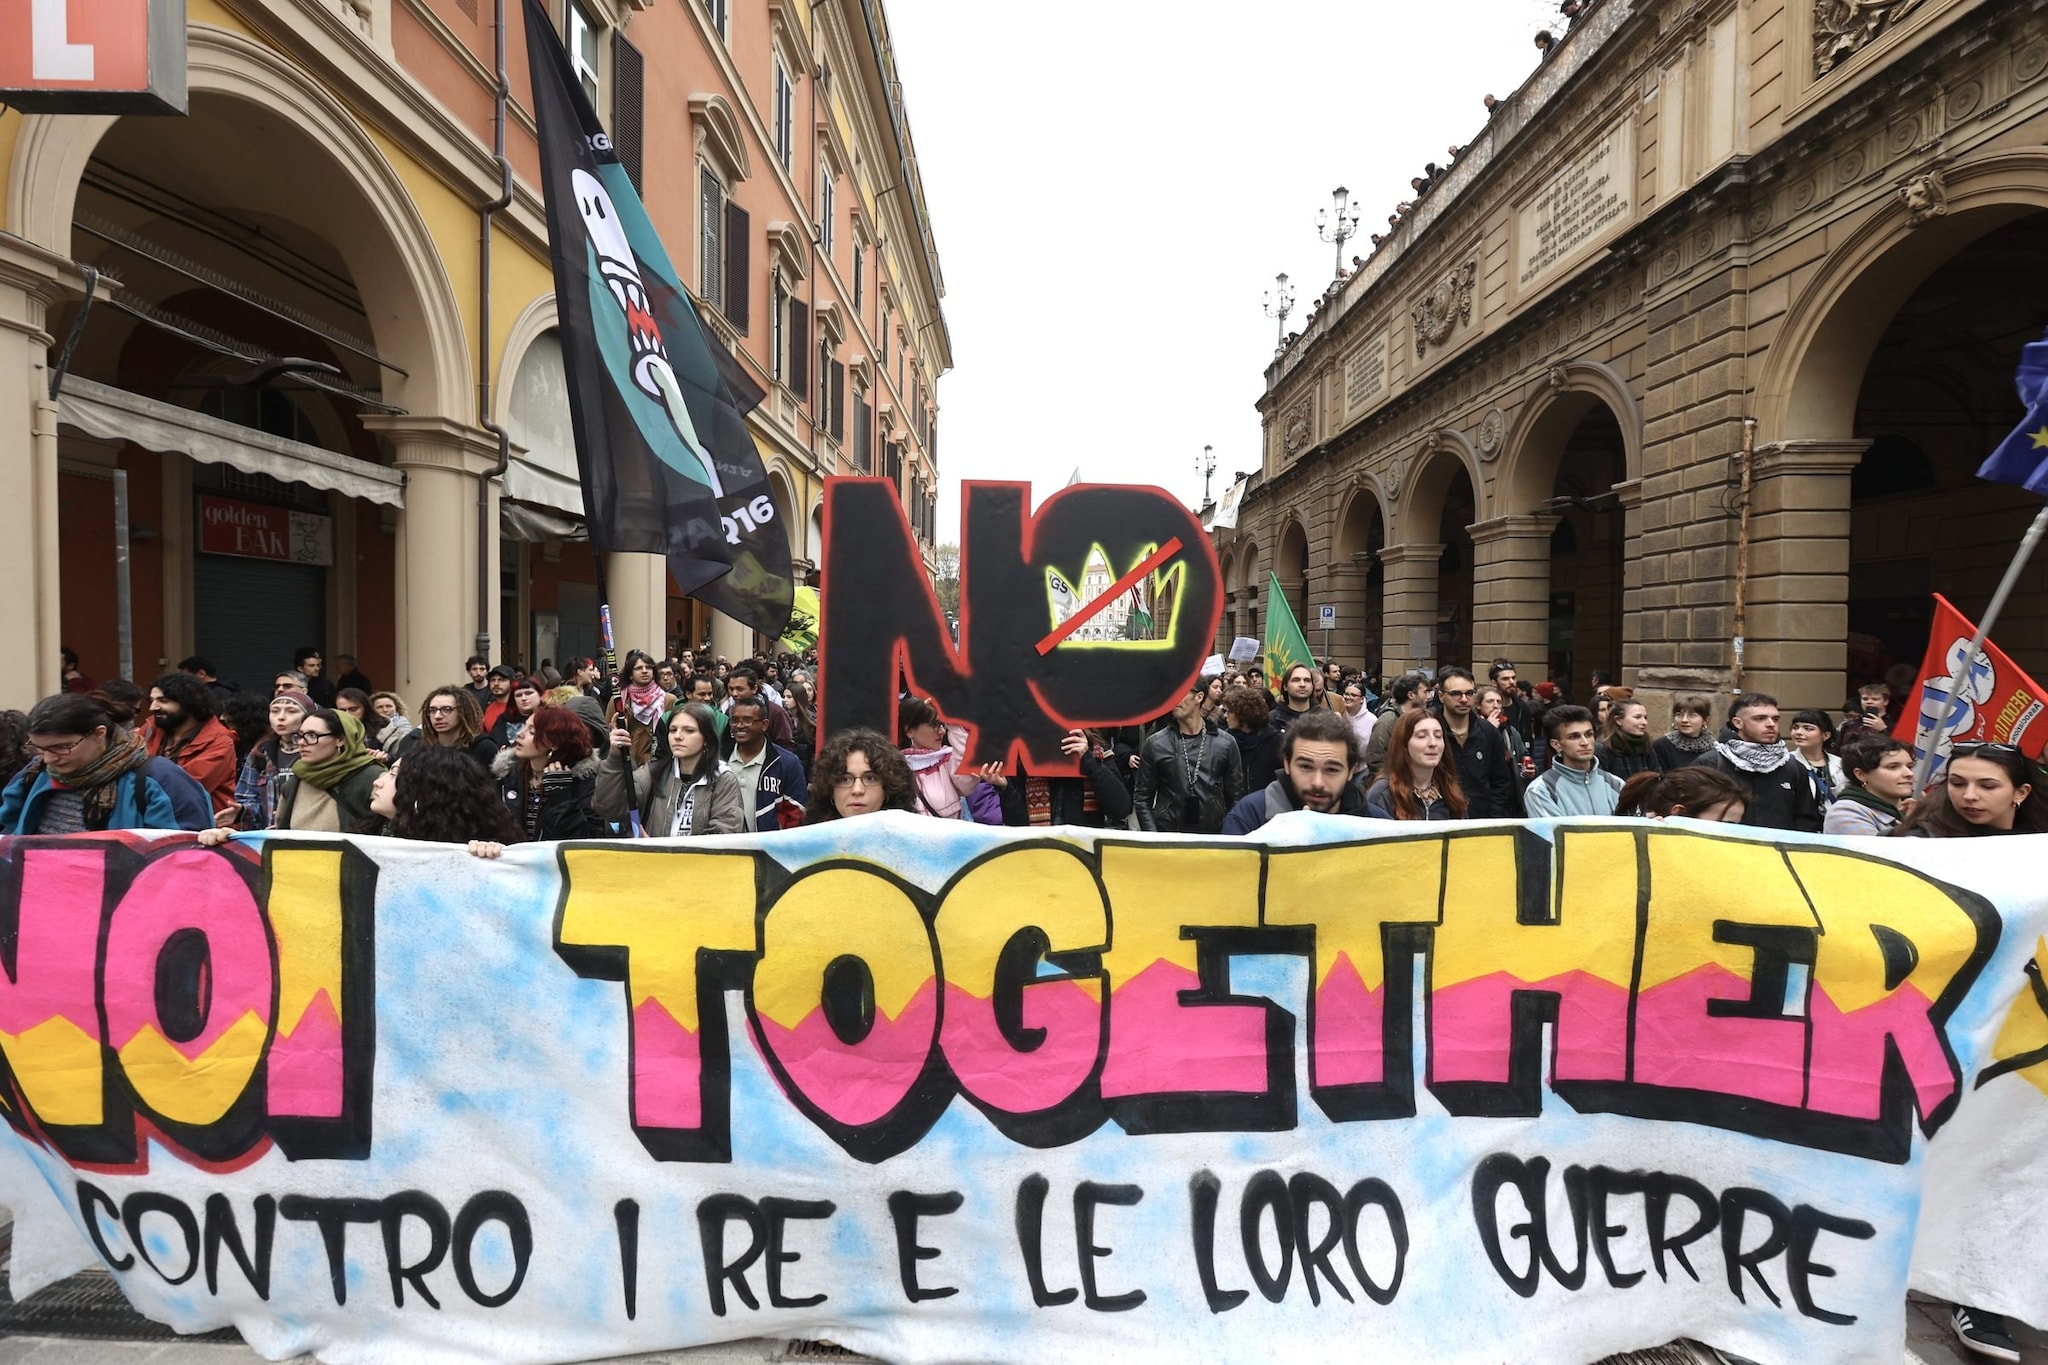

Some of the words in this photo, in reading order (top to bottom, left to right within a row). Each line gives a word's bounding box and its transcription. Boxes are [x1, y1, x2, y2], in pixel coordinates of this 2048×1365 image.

[205, 505, 268, 530] golden
[236, 527, 286, 557] BAR
[816, 475, 1226, 779] NO
[553, 826, 2001, 1165] TOGETHER
[77, 1180, 533, 1309] CONTRO
[614, 1199, 640, 1321] I
[696, 1193, 836, 1317] RE
[889, 1190, 964, 1303] E
[1016, 1172, 1147, 1312] LE
[1190, 1169, 1409, 1313] LORO
[1472, 1152, 1875, 1325] GUERRE
